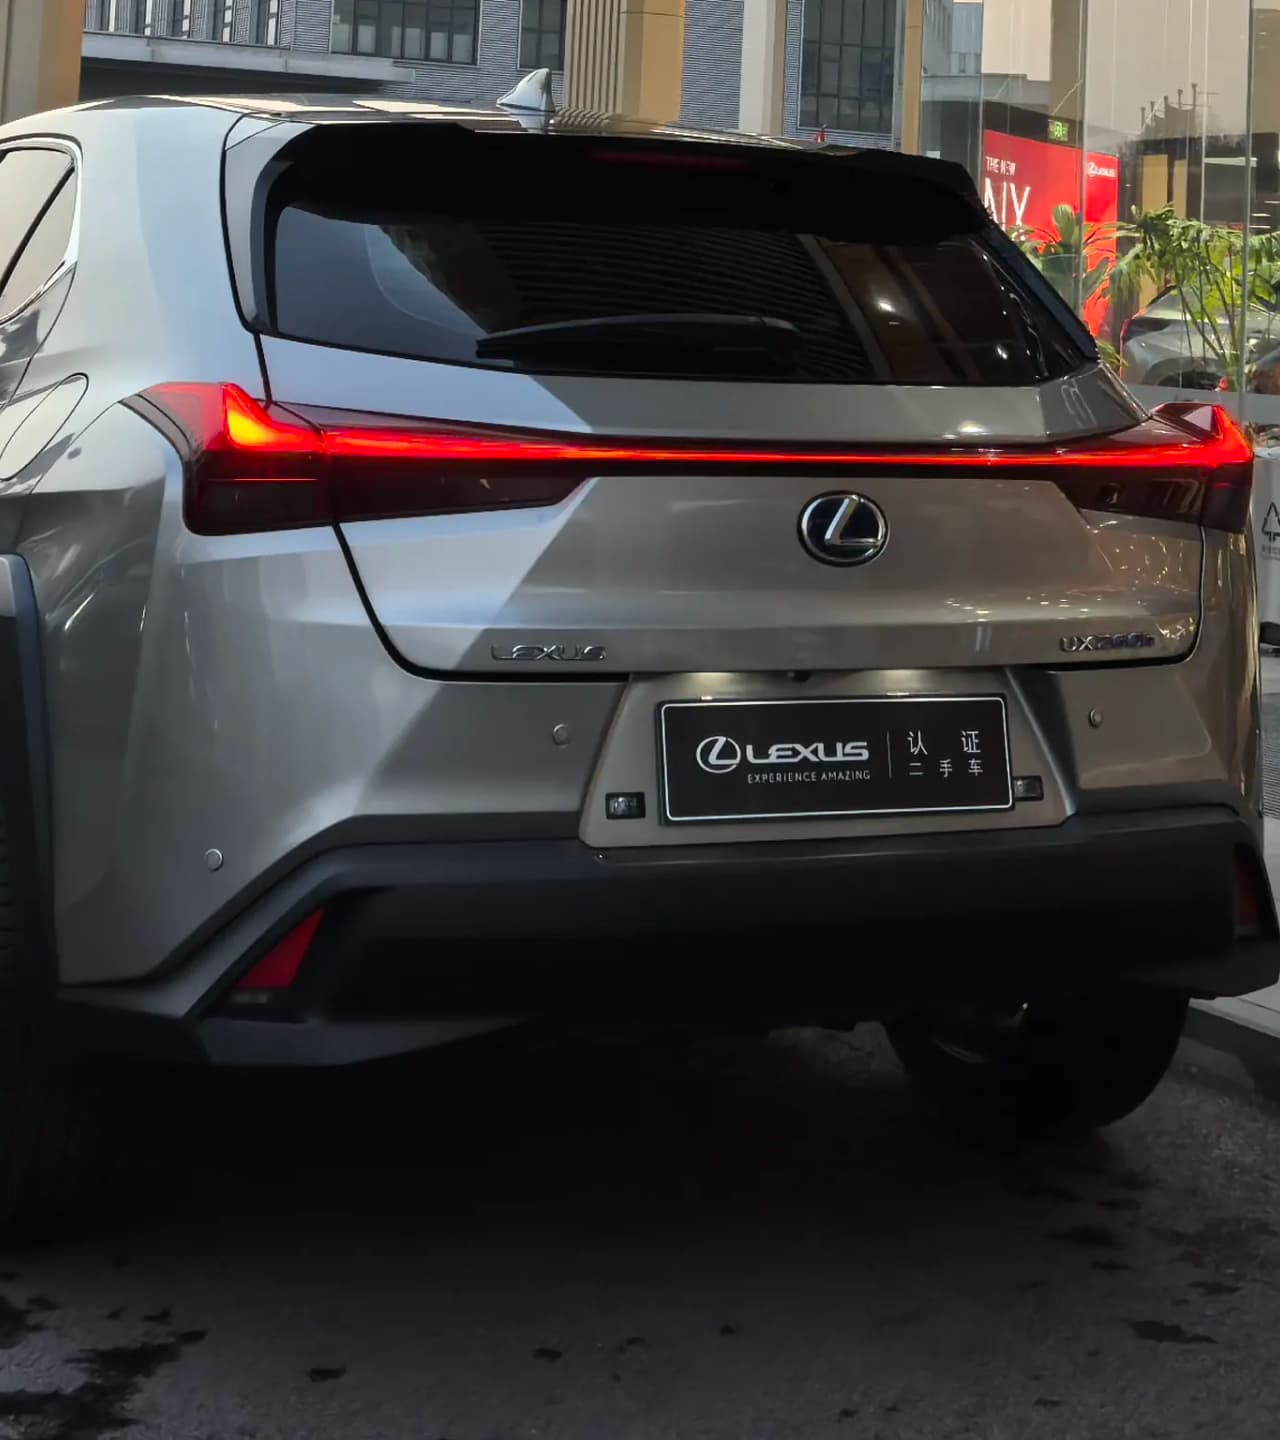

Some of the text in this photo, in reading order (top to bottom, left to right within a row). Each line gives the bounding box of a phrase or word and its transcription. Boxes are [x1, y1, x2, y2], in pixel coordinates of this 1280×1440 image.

[490, 644, 607, 661] LEXUS
[746, 740, 870, 764] LEXUS
[747, 770, 871, 785] EXPERIENCE AMAZING
